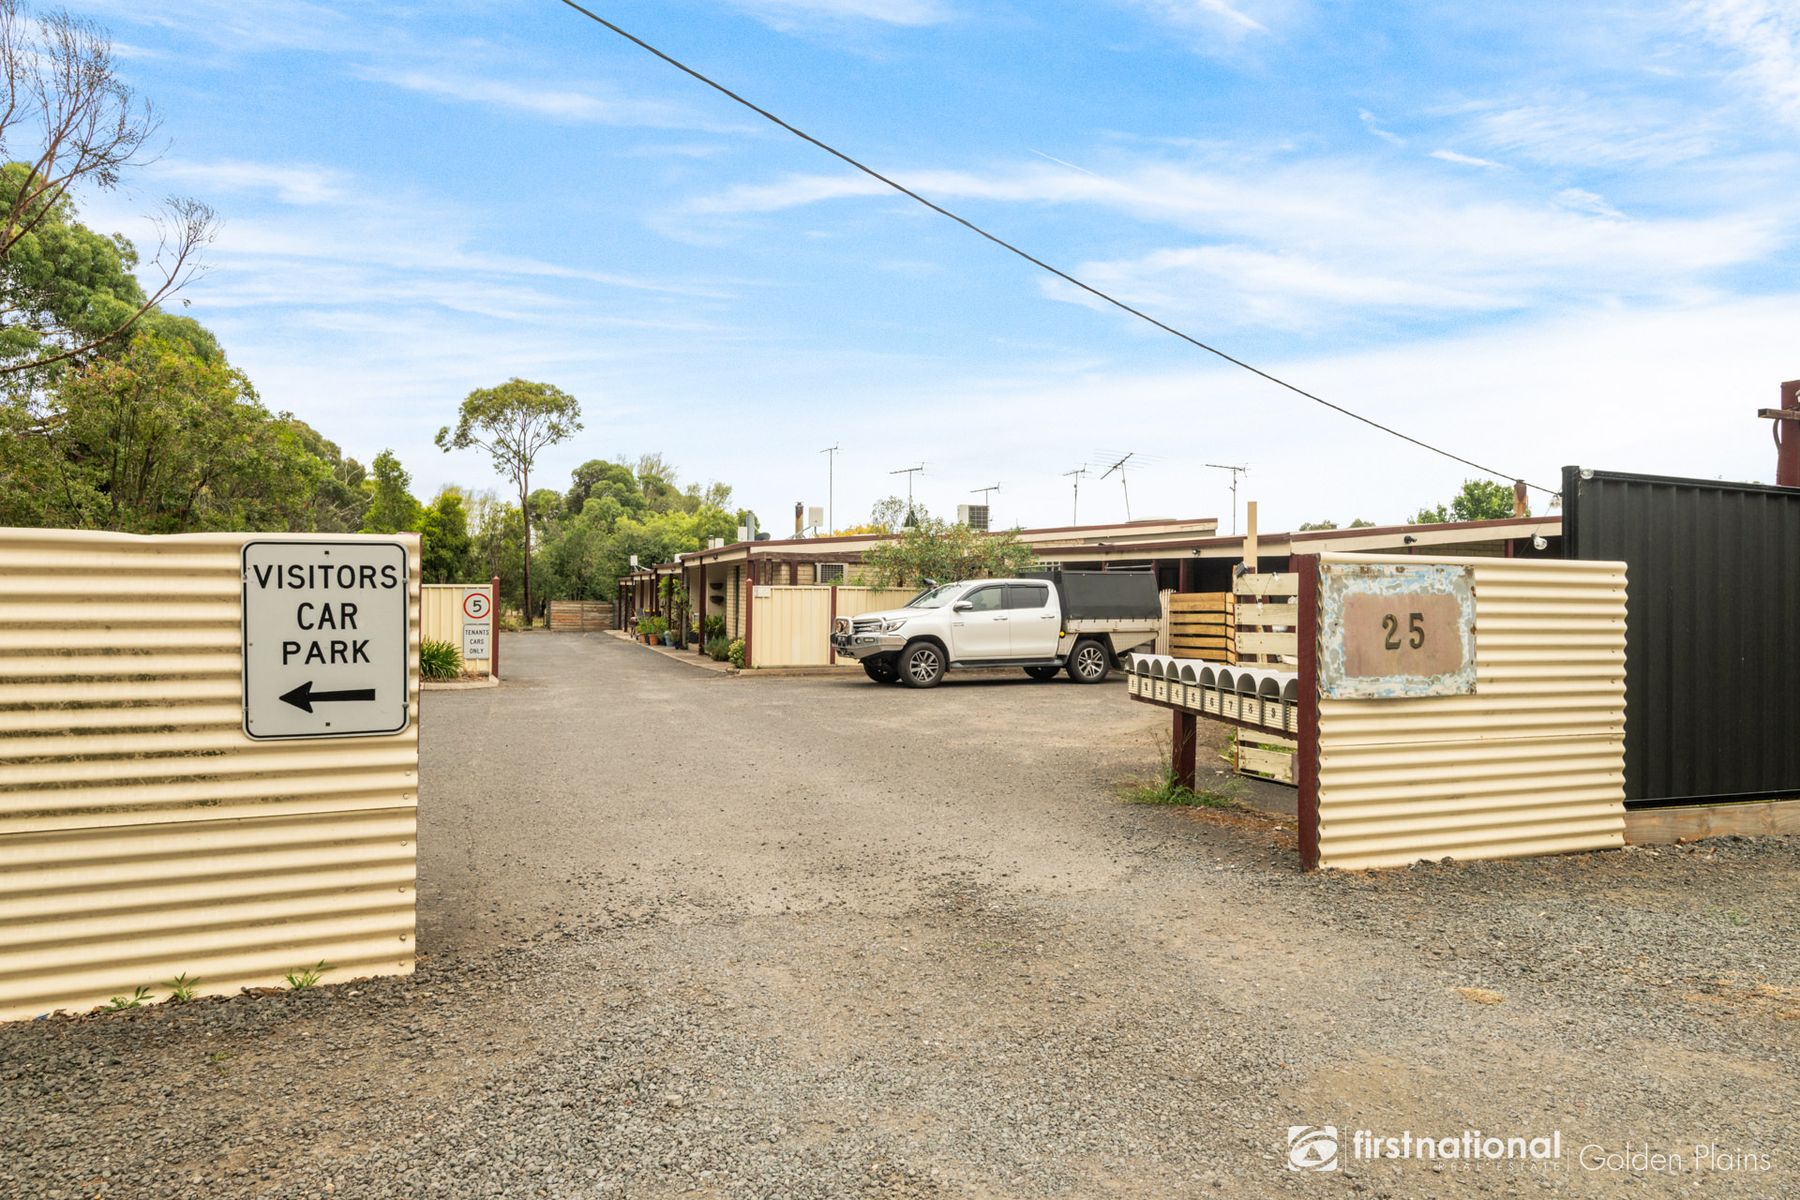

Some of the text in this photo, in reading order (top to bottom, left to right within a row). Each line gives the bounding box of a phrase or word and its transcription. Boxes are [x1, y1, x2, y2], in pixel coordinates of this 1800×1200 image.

[253, 564, 398, 590] VISITORS
[472, 600, 482, 613] 5
[297, 602, 358, 630] CAR
[1381, 612, 1425, 650] 25
[282, 640, 370, 665] PARK
[1191, 692, 1196, 703] 5
[1209, 697, 1214, 707] 6
[1228, 700, 1233, 711] 7
[1248, 703, 1253, 714] 8
[1271, 707, 1276, 718] 9
